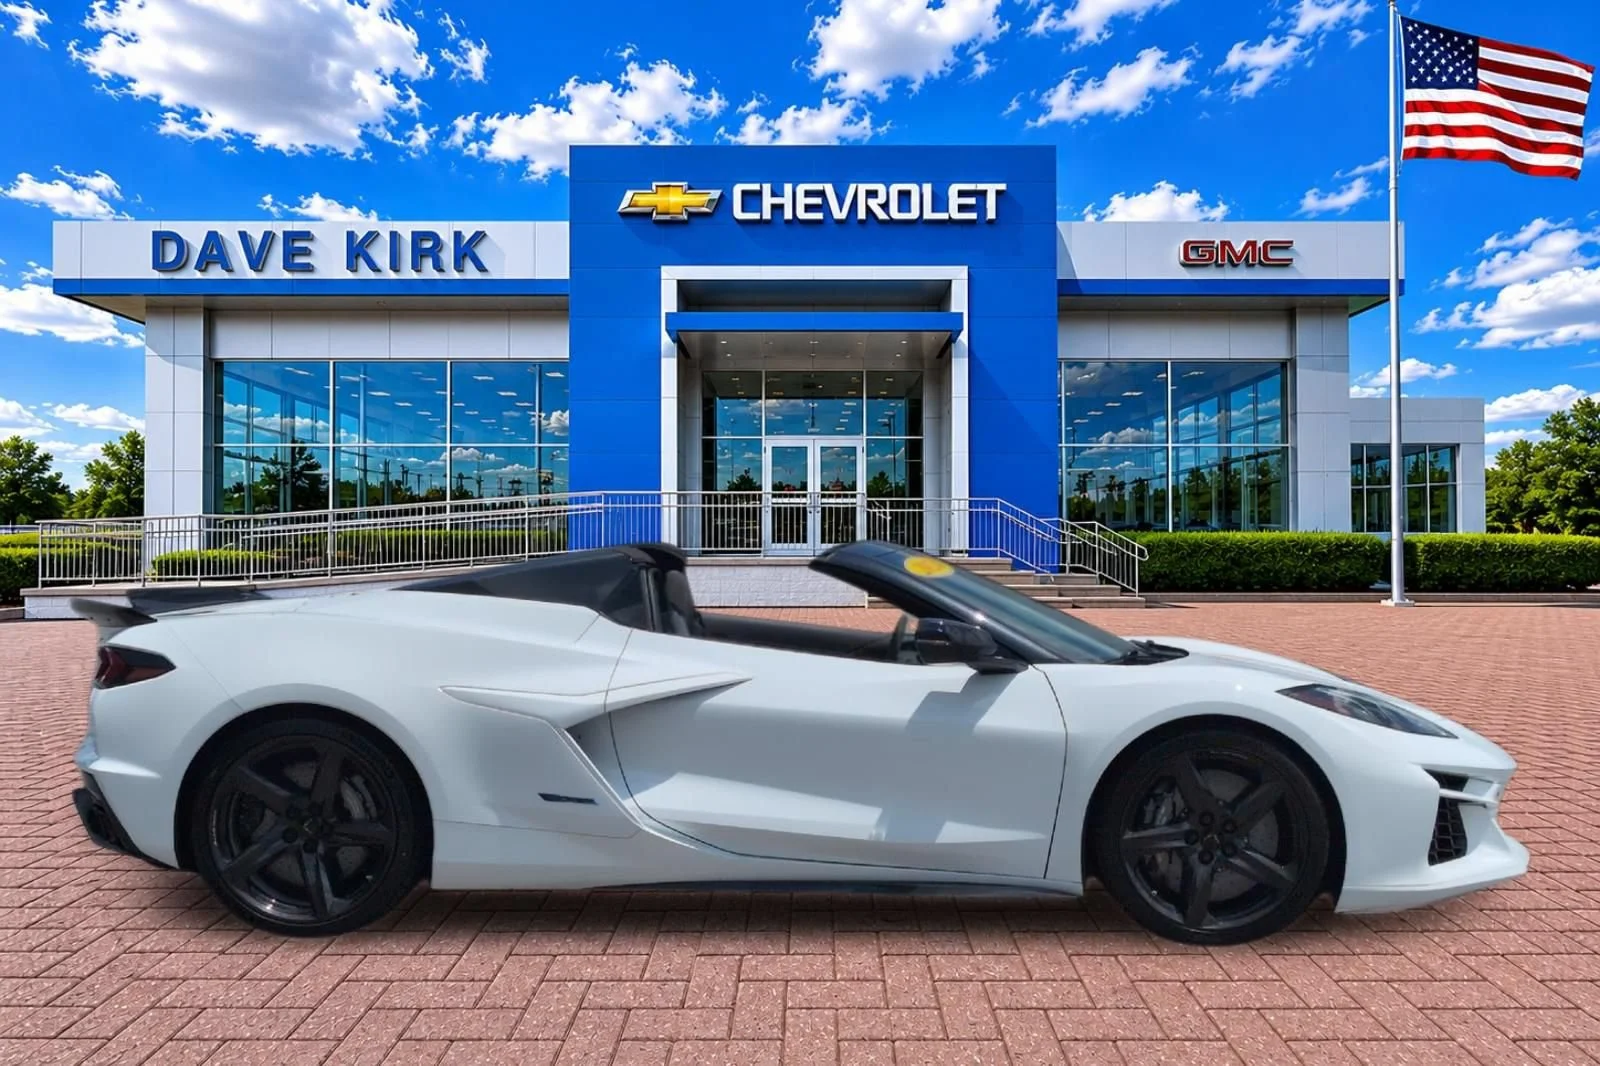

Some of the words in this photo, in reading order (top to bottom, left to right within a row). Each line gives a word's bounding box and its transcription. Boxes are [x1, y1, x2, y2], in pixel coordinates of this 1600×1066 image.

[732, 183, 1007, 221] CHEVROLET
[152, 230, 314, 272] DAVE
[346, 230, 488, 272] KIRK
[1180, 239, 1294, 266] GMC
